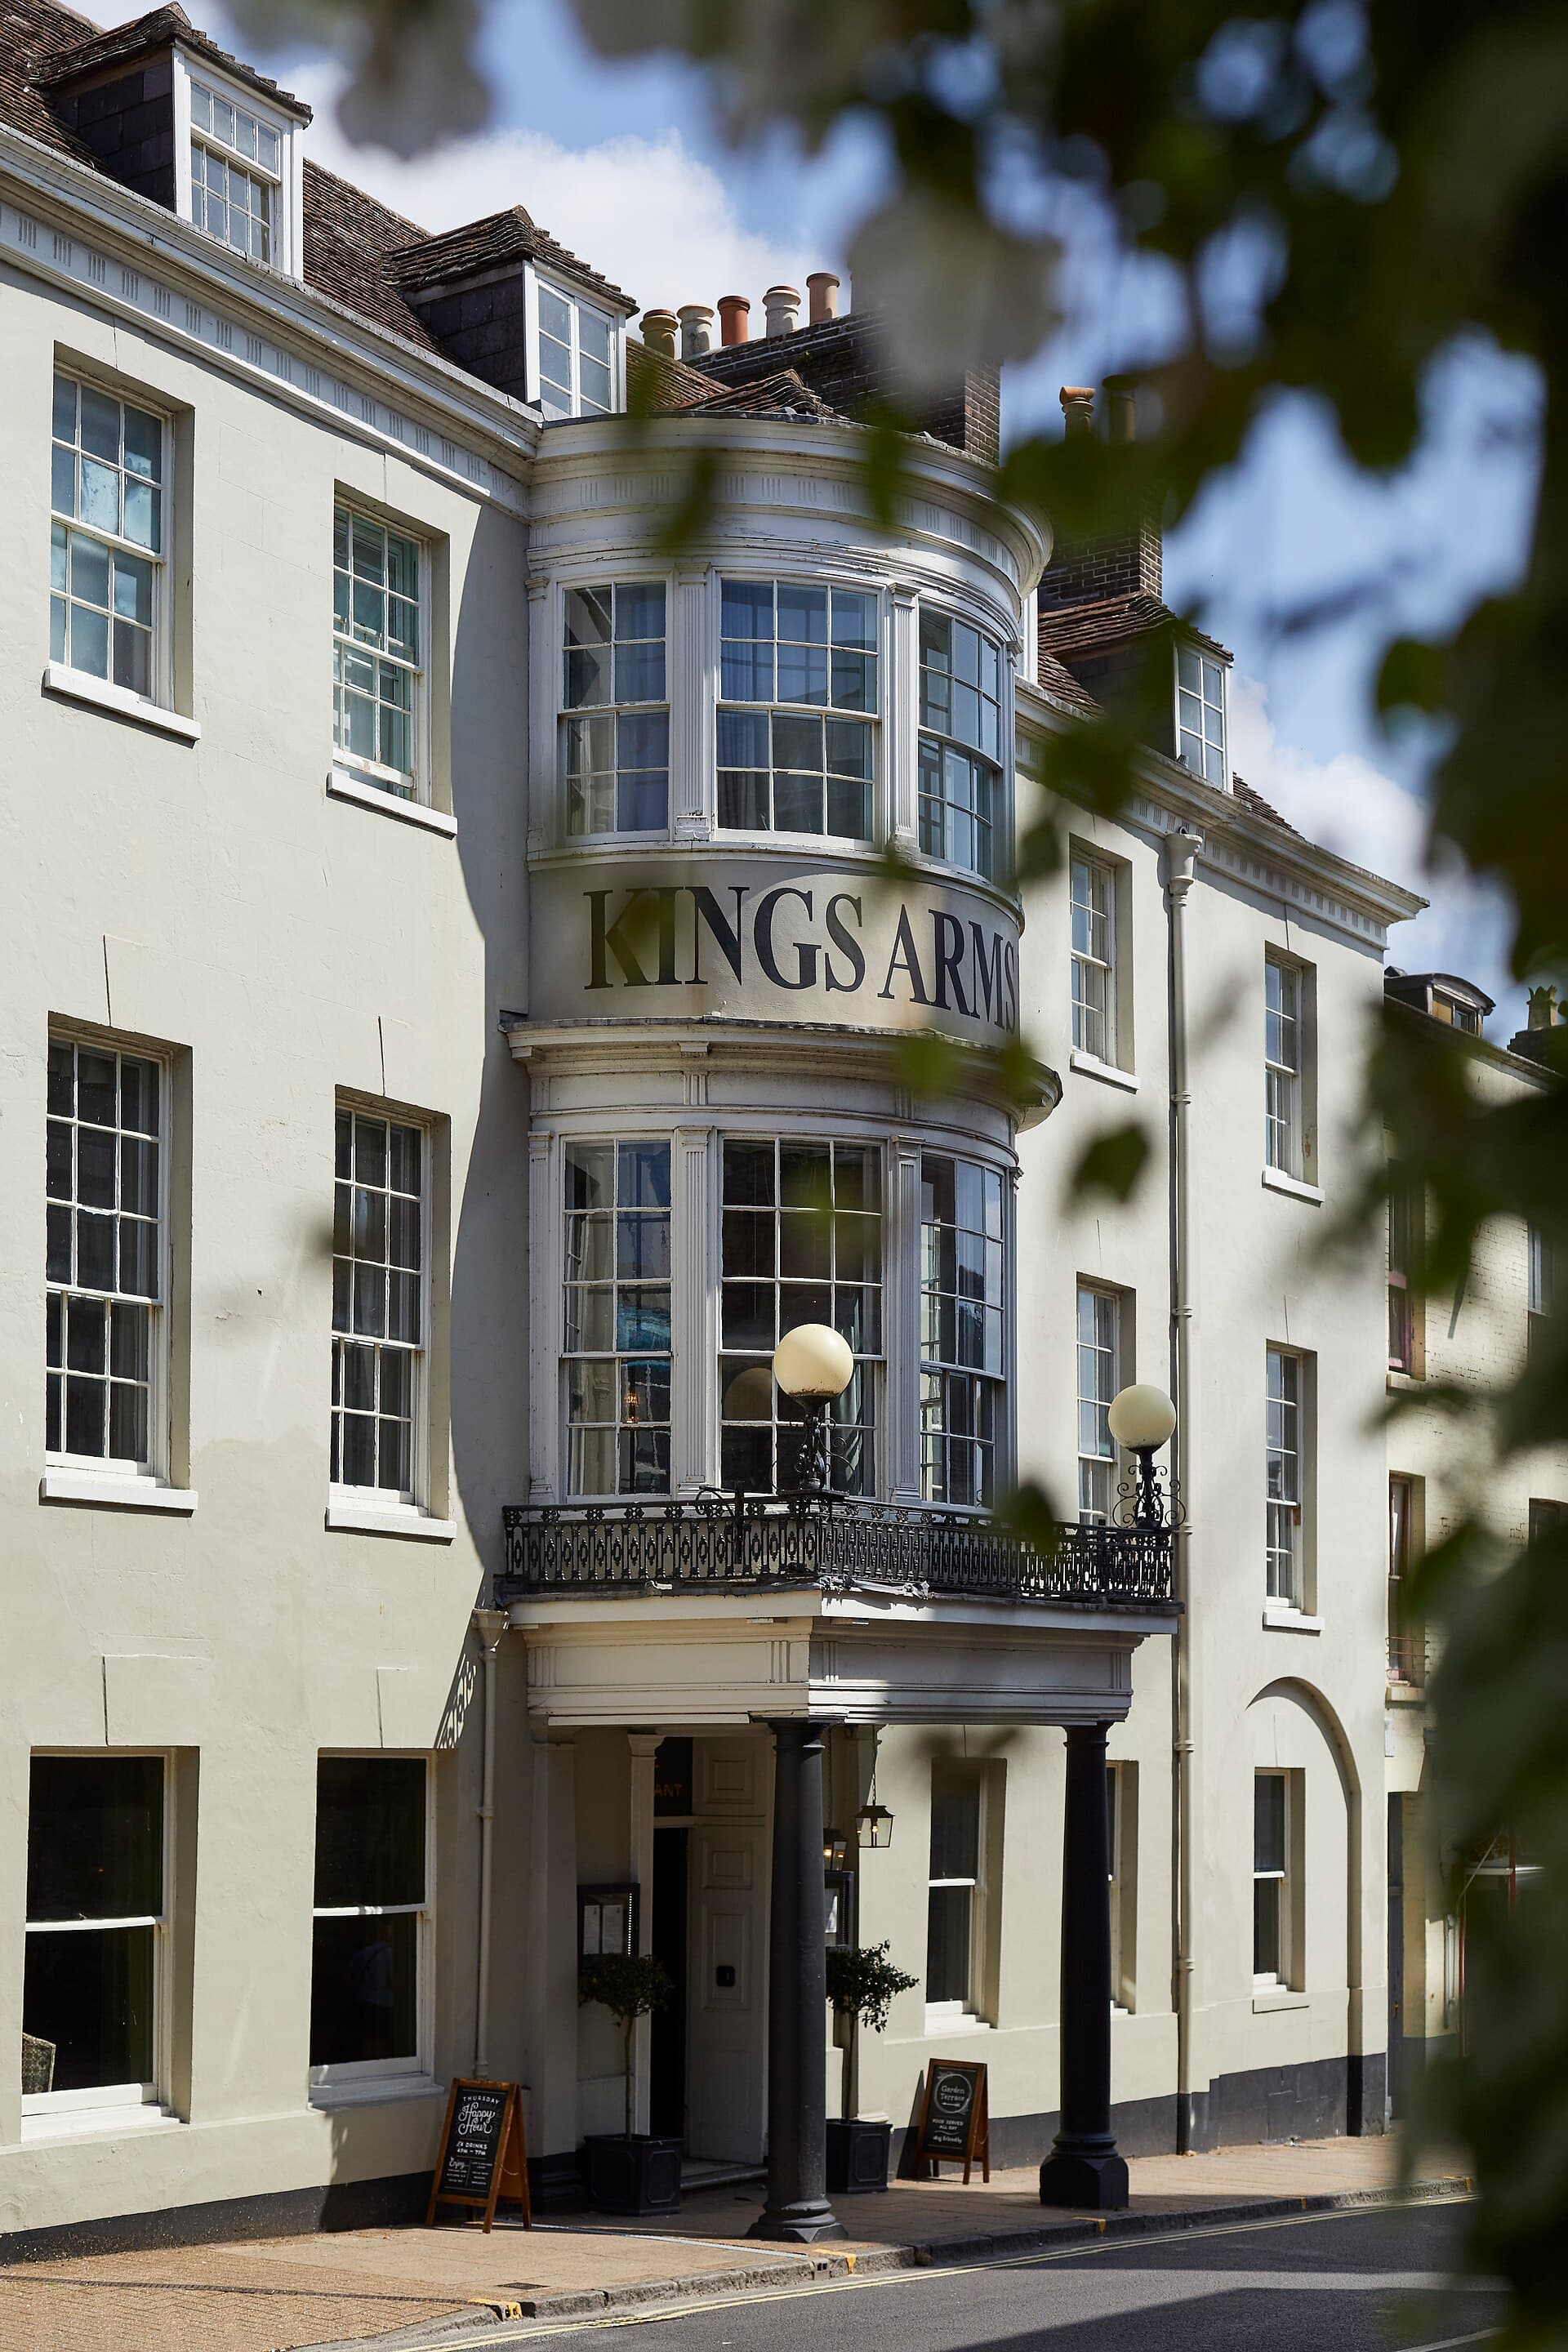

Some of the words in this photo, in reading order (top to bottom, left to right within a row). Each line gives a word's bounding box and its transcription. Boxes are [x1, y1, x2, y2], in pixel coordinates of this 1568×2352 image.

[583, 886, 866, 991] KINGS
[877, 903, 1016, 1035] ARMS
[941, 2085, 965, 2094] Garden
[463, 2096, 500, 2104] THURSDAY
[940, 2093, 965, 2101] Terrace
[458, 2101, 496, 2123] Happy
[458, 2118, 493, 2135] Hour
